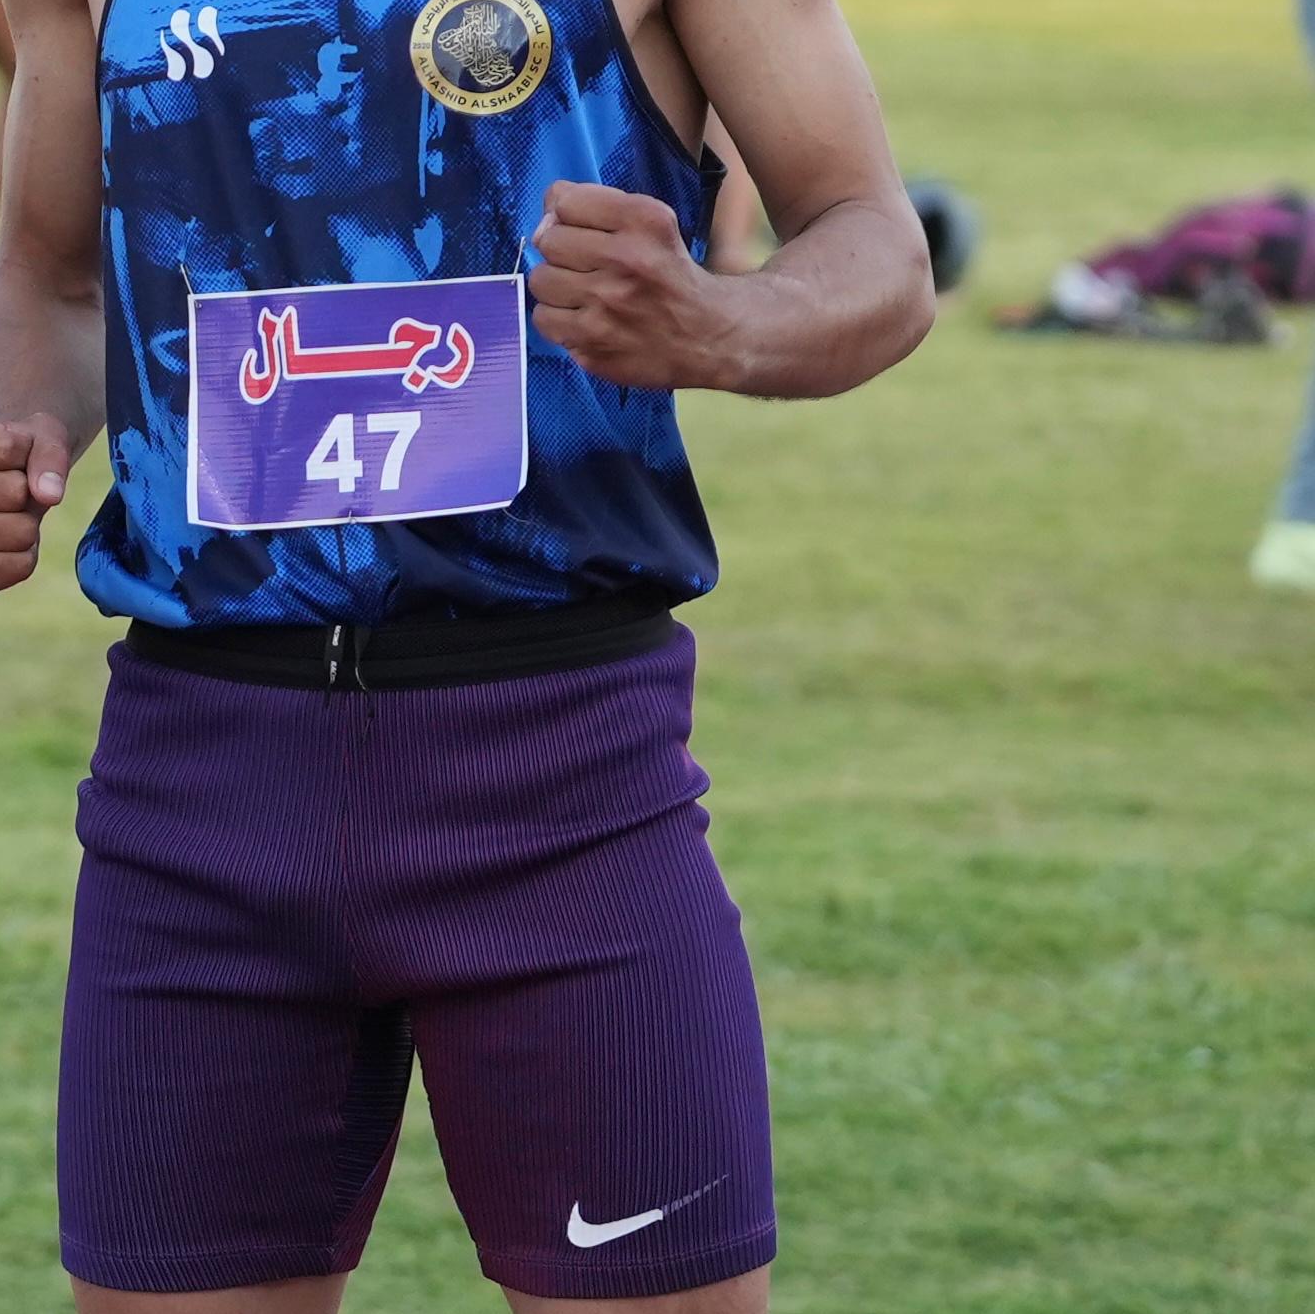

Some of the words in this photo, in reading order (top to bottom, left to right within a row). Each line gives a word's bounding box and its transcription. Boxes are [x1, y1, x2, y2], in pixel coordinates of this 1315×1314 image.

[526, 8, 545, 35] نادي
[419, 56, 467, 106] ALHASHID
[471, 75, 533, 109] ALSHAABI
[529, 56, 543, 74] SC
[239, 305, 476, 405] رجال
[305, 410, 422, 493] 47
